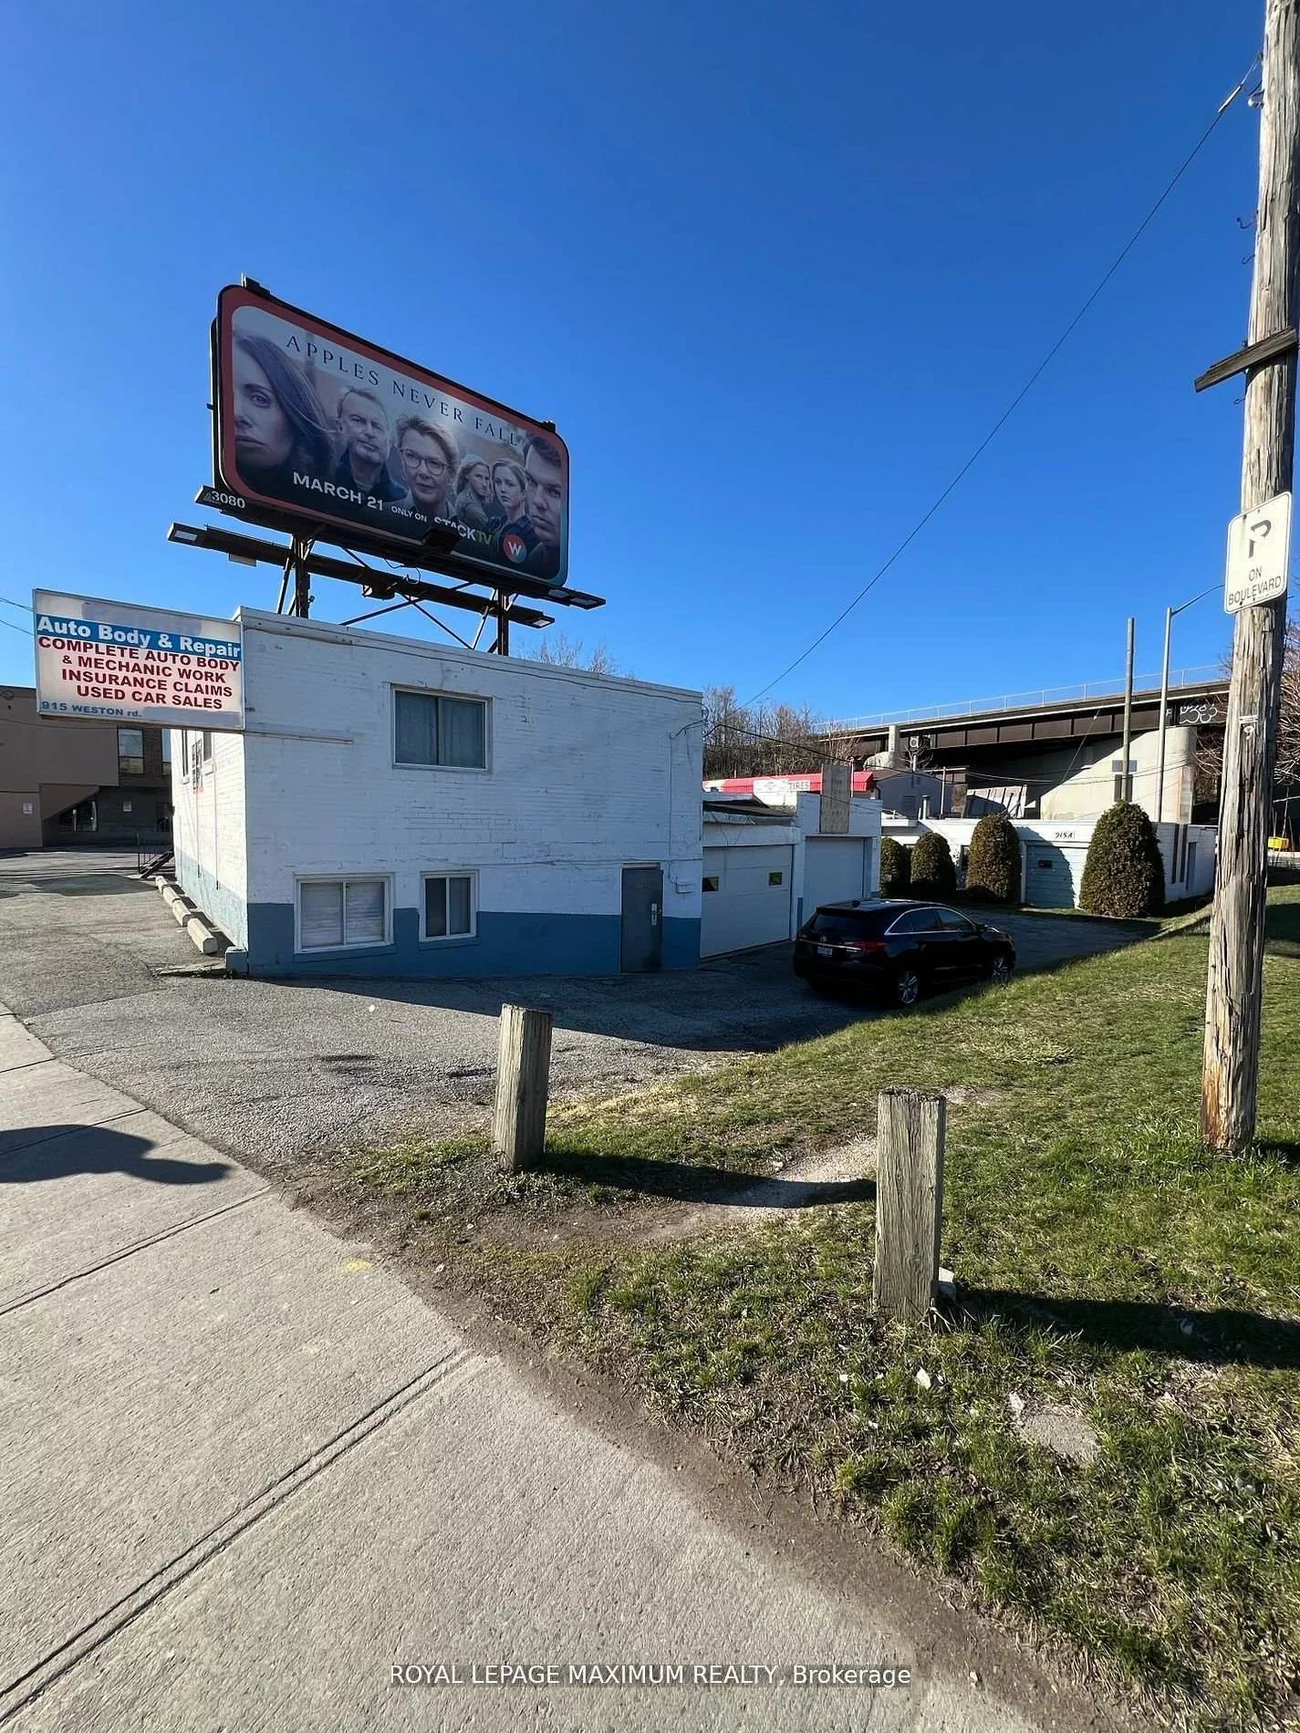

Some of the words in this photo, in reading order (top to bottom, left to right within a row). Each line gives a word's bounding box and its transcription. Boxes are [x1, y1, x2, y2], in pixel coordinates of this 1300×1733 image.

[286, 334, 379, 387] APPLES
[392, 383, 464, 423] NEVER
[474, 416, 519, 447] FALL
[211, 490, 246, 509] 3080
[292, 471, 362, 505] MARCH
[366, 495, 384, 512] 21
[390, 505, 413, 518] ONLY
[414, 513, 428, 522] ON
[1248, 565, 1263, 582] ON
[1228, 575, 1282, 606] BOULEVARD
[37, 615, 91, 638] Auto
[98, 625, 151, 649] Body
[157, 633, 173, 649] &
[180, 636, 240, 658] Repair
[38, 636, 139, 660] COMPLETE
[145, 650, 191, 666] AUTO
[196, 657, 240, 672] BODY
[62, 654, 73, 664] &
[77, 655, 177, 678] MECHANIC
[177, 668, 226, 684] WORK
[62, 668, 167, 691] INSURANCE
[173, 681, 233, 697] CLAIMS
[41, 700, 67, 711] 915
[71, 704, 124, 717] WESTON
[126, 709, 142, 718] rd.
[76, 685, 126, 701] USED
[131, 690, 166, 704] CAR
[171, 694, 223, 709] SALES
[787, 780, 809, 791] TIRES
